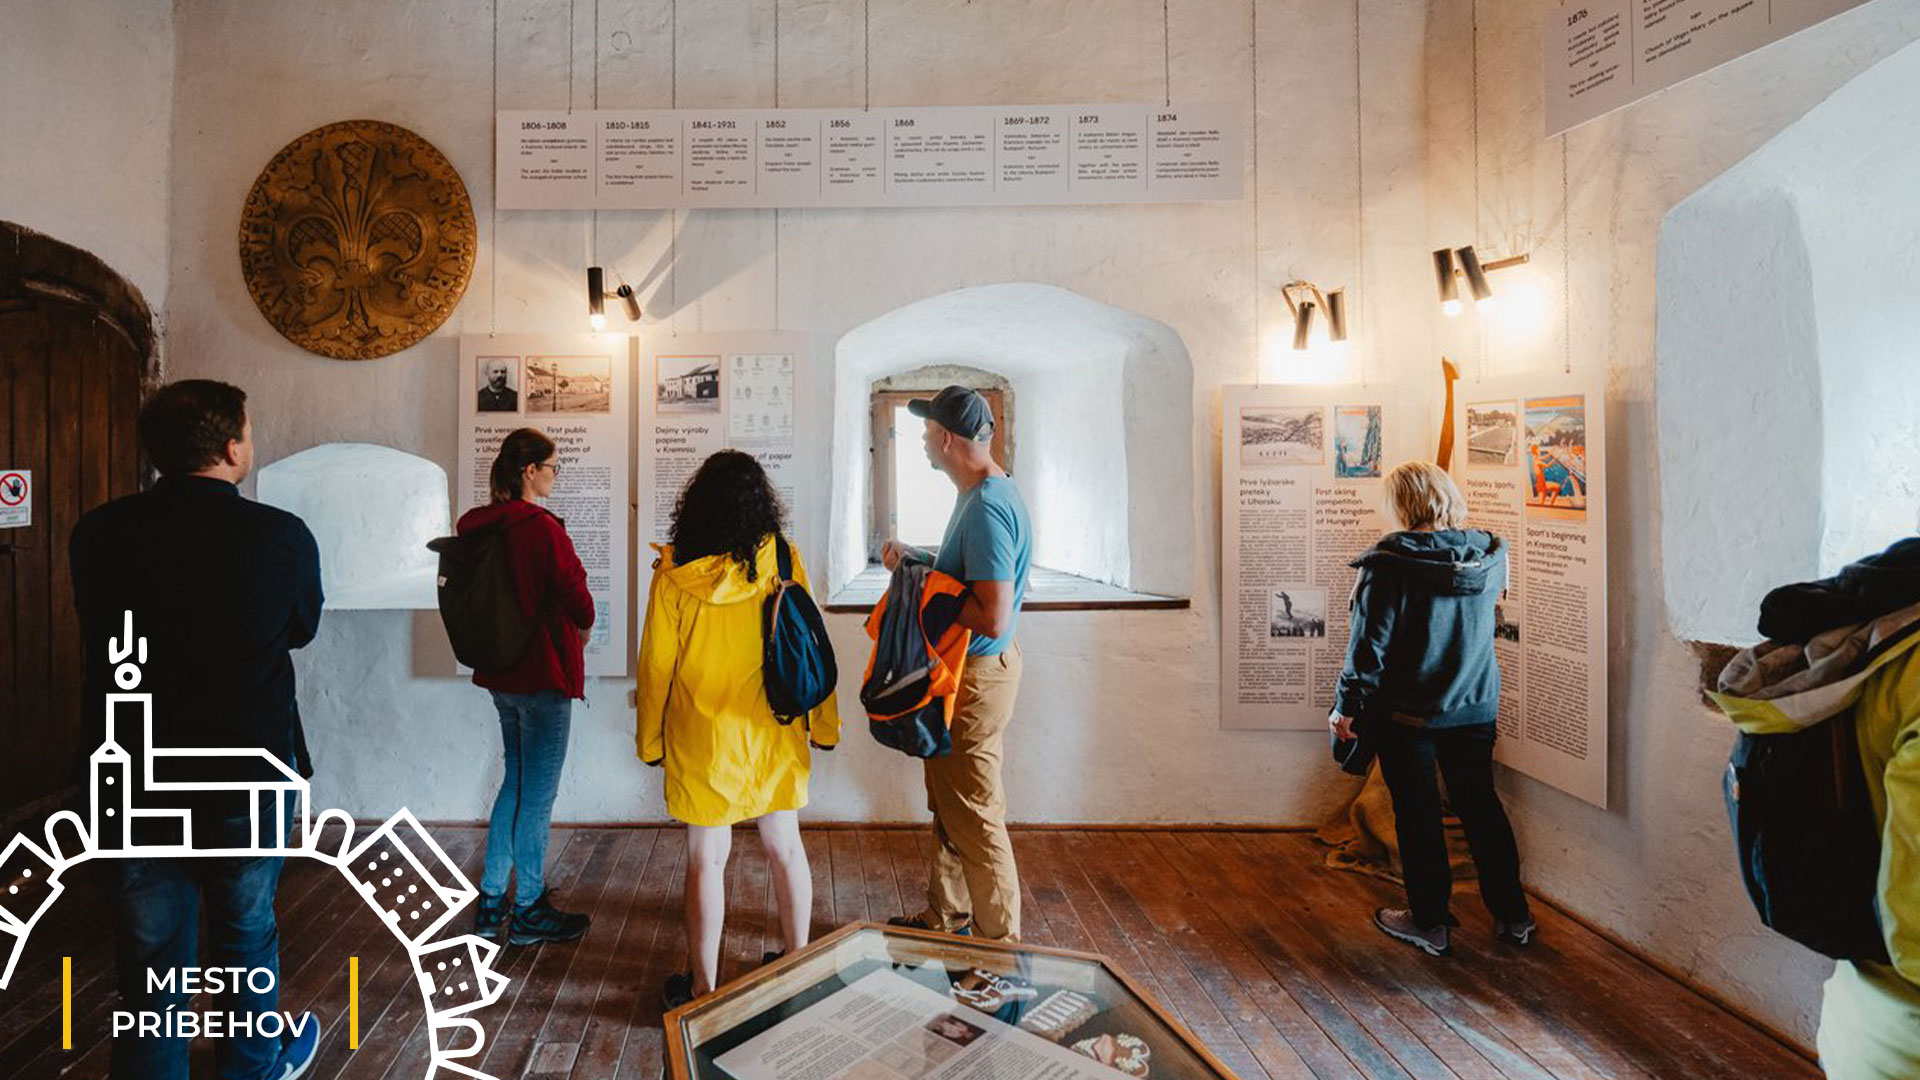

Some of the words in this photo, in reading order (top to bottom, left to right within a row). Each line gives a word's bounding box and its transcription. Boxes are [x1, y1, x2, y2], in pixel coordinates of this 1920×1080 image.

[1078, 115, 1098, 124] 1873
[1157, 114, 1177, 122] 1874
[564, 426, 587, 435] public
[582, 445, 591, 453] of
[1334, 488, 1356, 497] skiing
[1316, 499, 1363, 507] competition
[1340, 508, 1375, 517] Kingdom
[1326, 518, 1360, 527] Hungary
[1551, 530, 1586, 545] beginning
[1534, 540, 1568, 552] Kremnica
